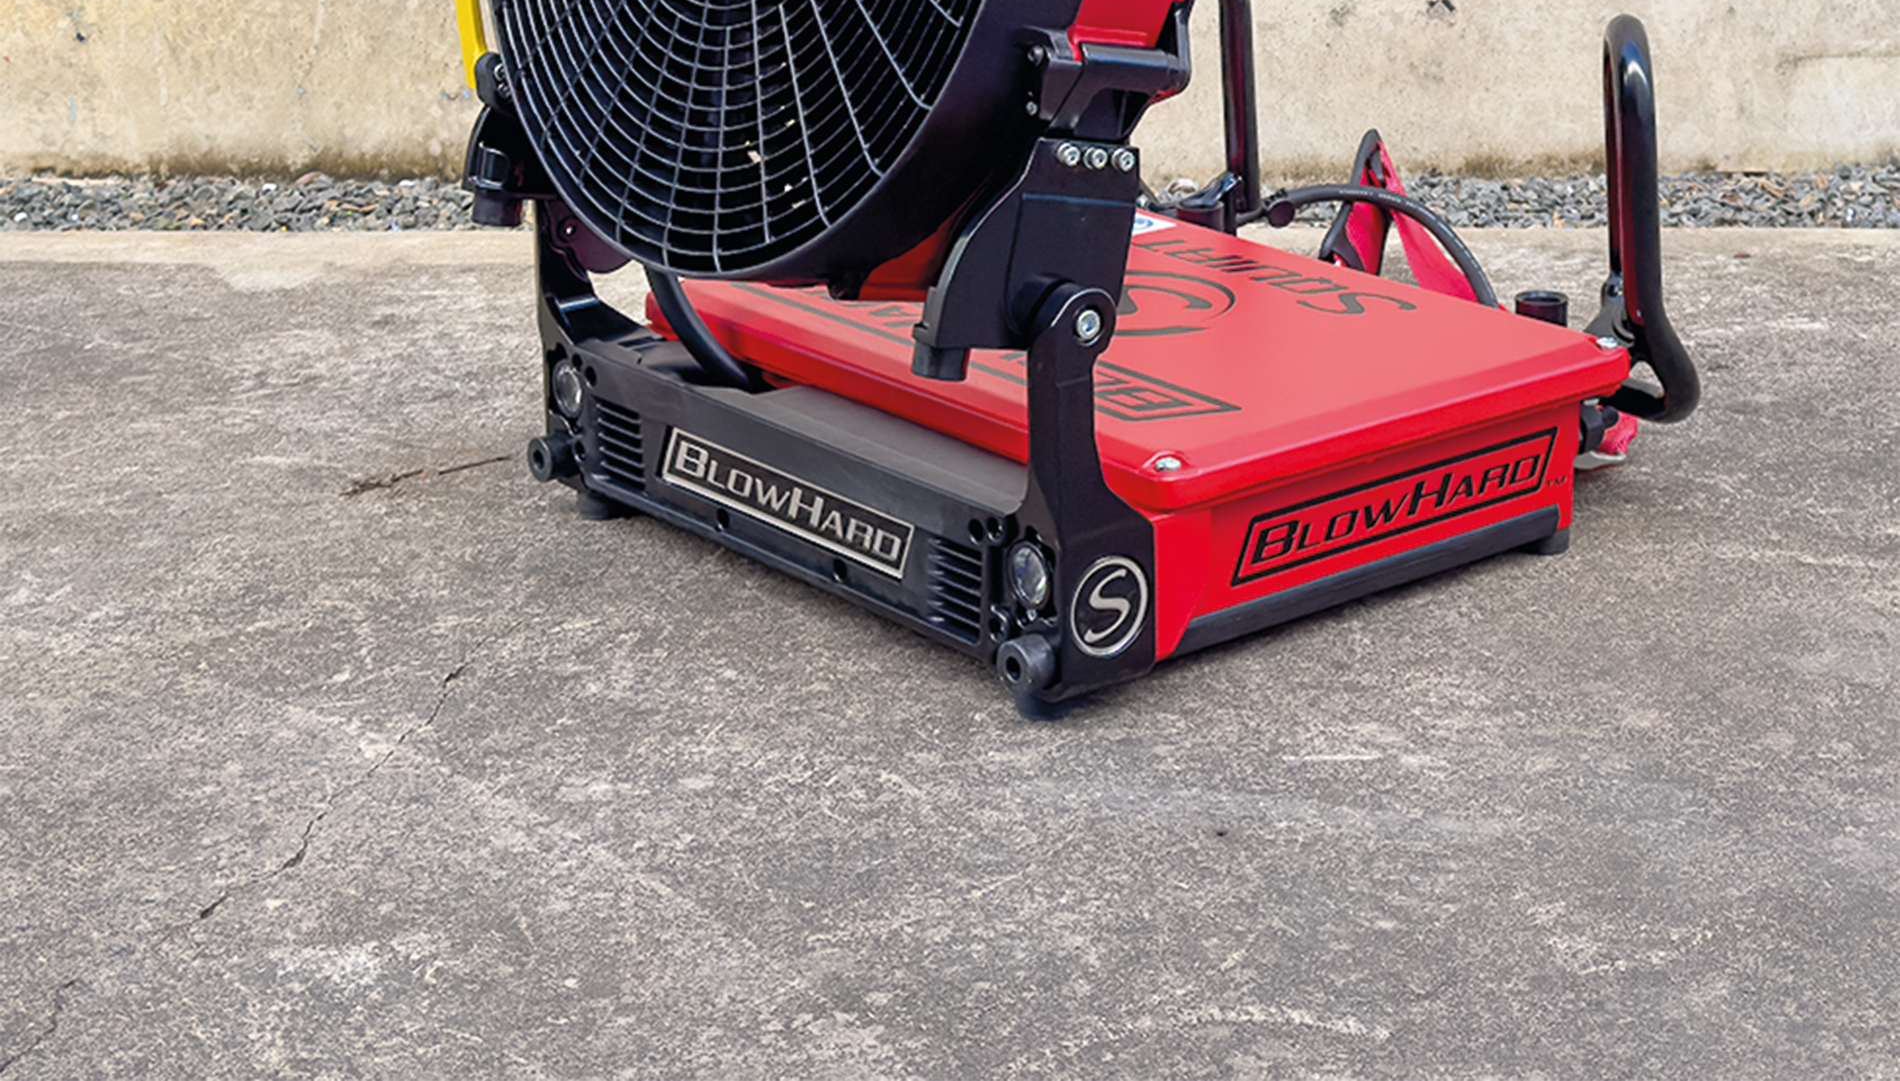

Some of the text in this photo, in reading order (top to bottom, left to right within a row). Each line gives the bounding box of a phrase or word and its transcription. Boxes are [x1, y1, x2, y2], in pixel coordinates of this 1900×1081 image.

[1131, 239, 1417, 315] SQUIRT
[675, 441, 901, 561] BLOWHARD
[1251, 454, 1541, 565] BLOWHARD
